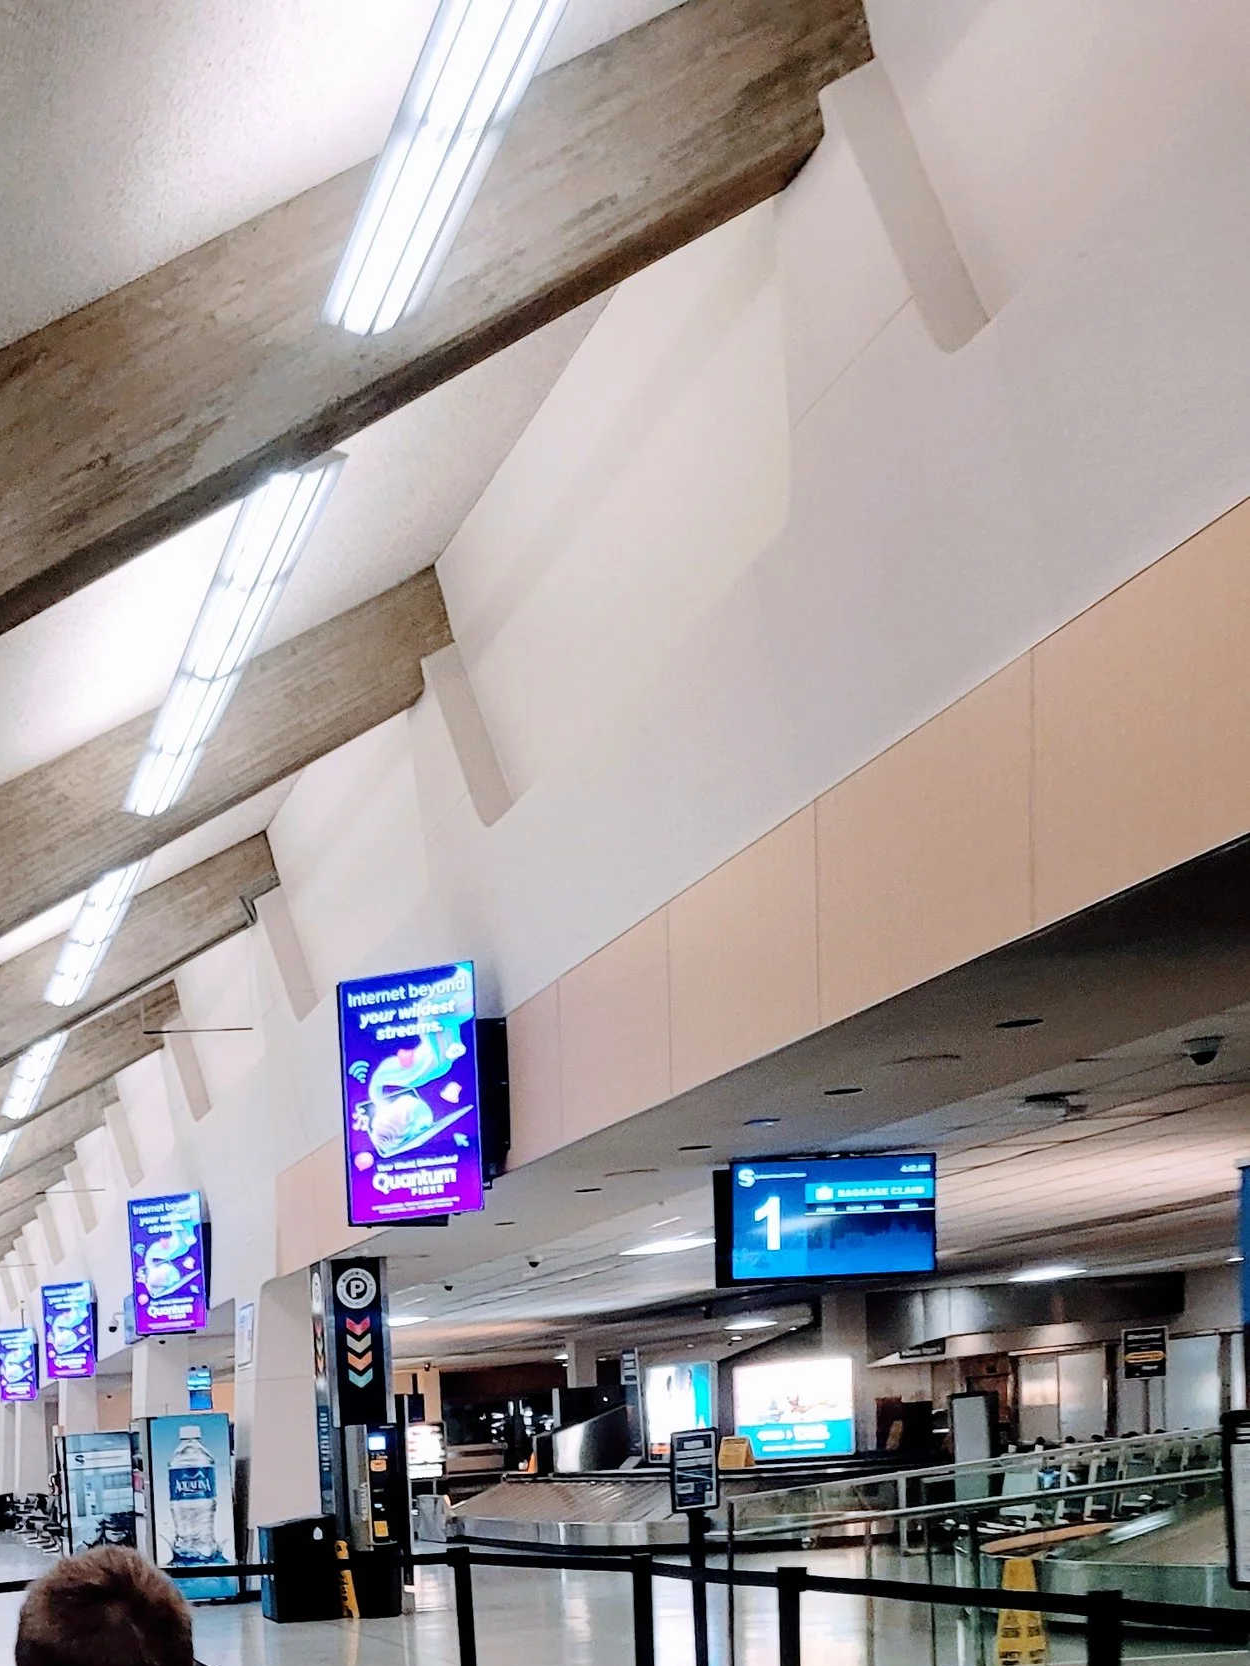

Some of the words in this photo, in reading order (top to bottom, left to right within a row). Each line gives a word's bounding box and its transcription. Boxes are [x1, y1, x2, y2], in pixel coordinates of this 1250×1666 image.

[347, 985, 406, 1008] Internet
[408, 975, 466, 999] beyond
[359, 1009, 397, 1029] your
[398, 999, 456, 1020] wildest
[372, 1167, 457, 1195] Quantum
[754, 1196, 782, 1251] 1
[350, 1280, 365, 1299] P
